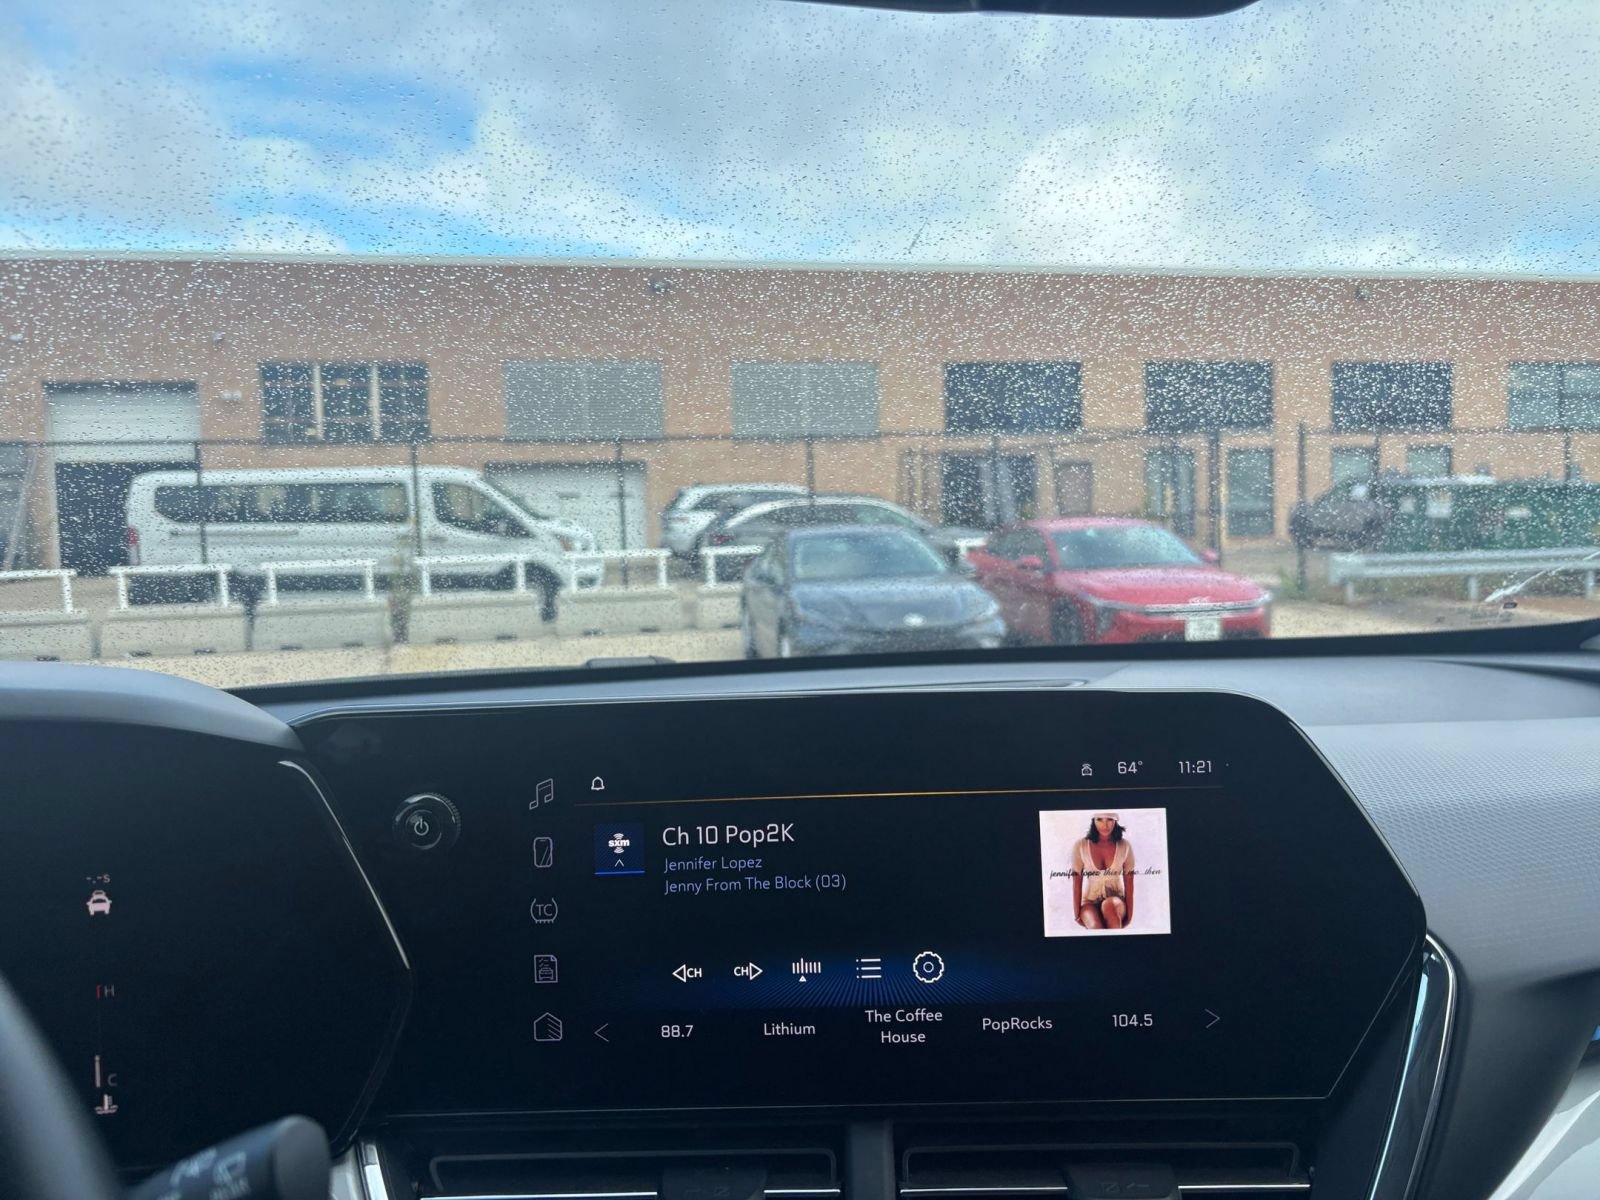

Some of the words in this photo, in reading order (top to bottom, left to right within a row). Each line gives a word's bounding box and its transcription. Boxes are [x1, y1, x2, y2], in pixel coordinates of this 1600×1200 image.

[1178, 760, 1213, 774] 11:21
[608, 838, 630, 847] sxm
[662, 827, 689, 846] Ch
[696, 825, 718, 844] 10
[726, 823, 795, 848] Pop2K
[664, 856, 717, 873] Jennifer
[721, 857, 763, 871] Lopez
[664, 879, 702, 895] Jenny
[705, 877, 742, 891] From
[744, 876, 771, 890] The
[774, 874, 812, 889] Block
[815, 873, 847, 891] (03)
[536, 904, 553, 916] TC
[687, 966, 702, 978] CH
[733, 966, 750, 977] CH
[104, 985, 115, 997] H
[864, 1009, 892, 1023] The
[895, 1009, 943, 1022] Coffee
[1112, 1013, 1153, 1028] 104.5
[661, 1024, 694, 1039] 88.7
[763, 1021, 816, 1036] Lithium
[982, 1015, 1053, 1034] PopRocks
[880, 1030, 926, 1044] House
